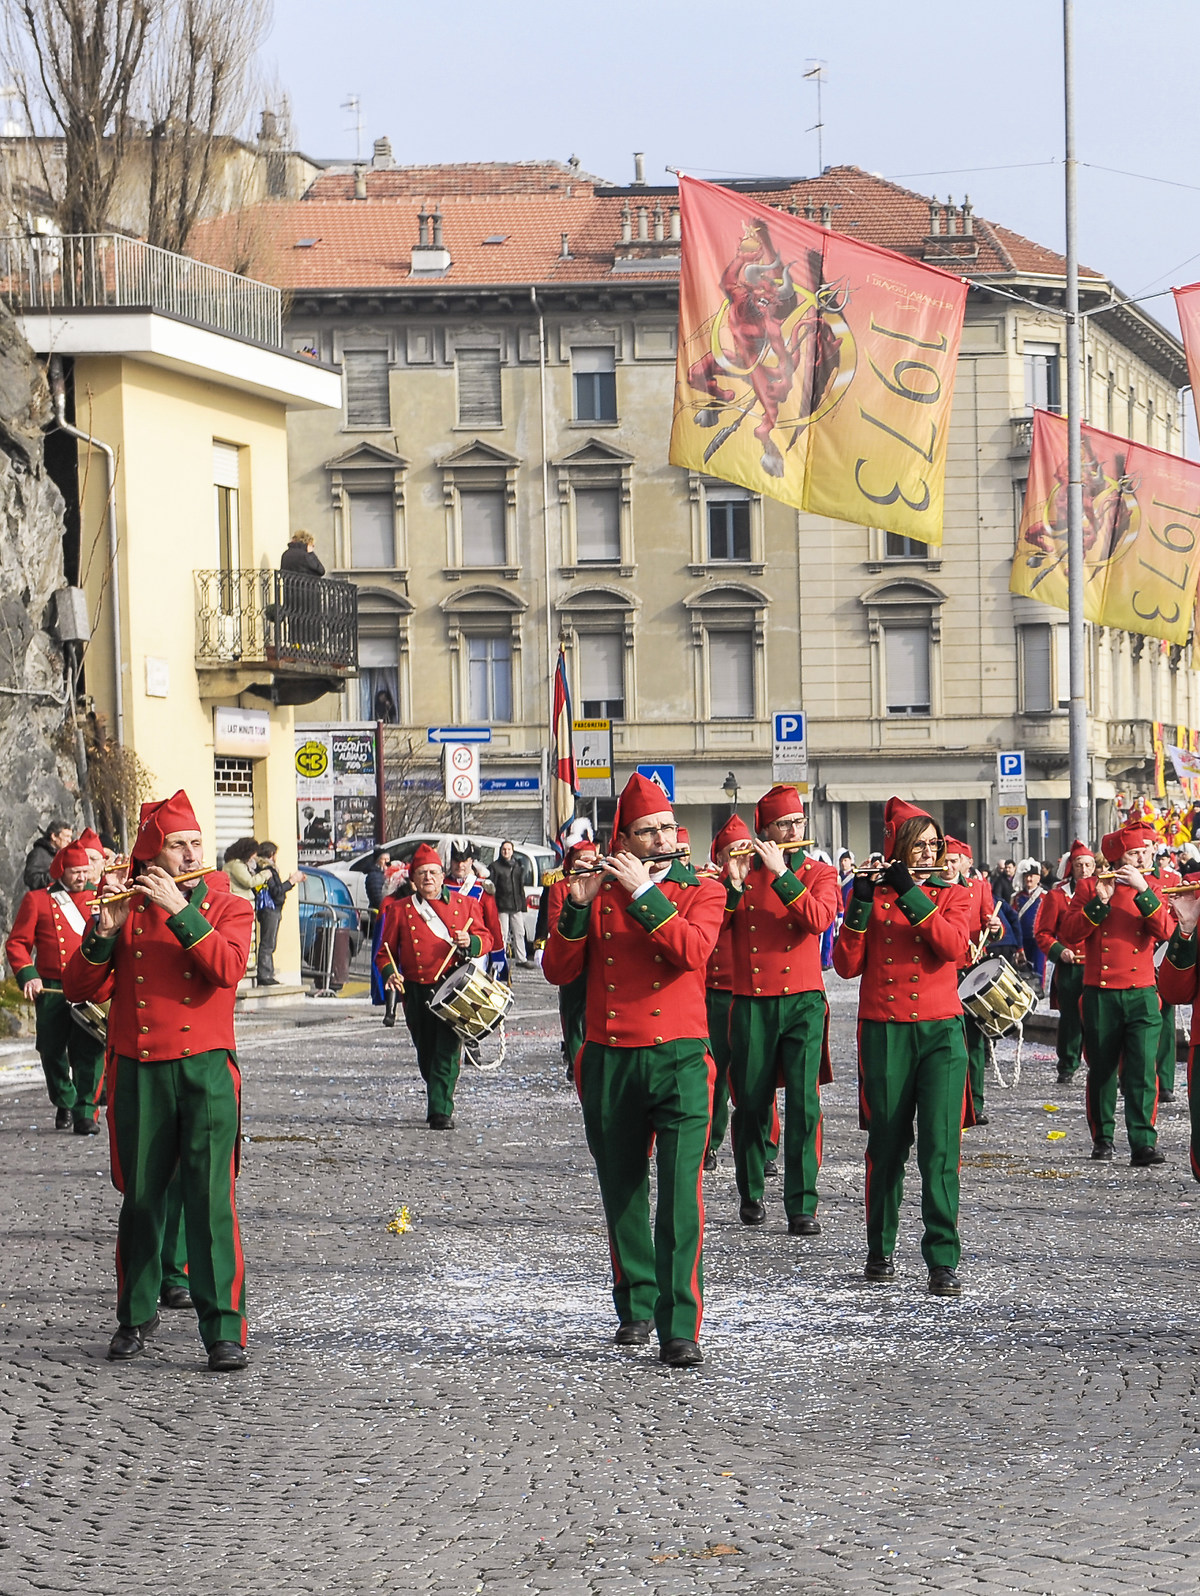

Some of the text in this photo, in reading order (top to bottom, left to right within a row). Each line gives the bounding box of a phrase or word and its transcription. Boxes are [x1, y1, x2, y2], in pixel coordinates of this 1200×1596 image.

[855, 312, 948, 511] 1973
[228, 724, 266, 735] LAST MINUTE TOUR
[781, 717, 798, 739] P
[1004, 756, 1018, 774] P
